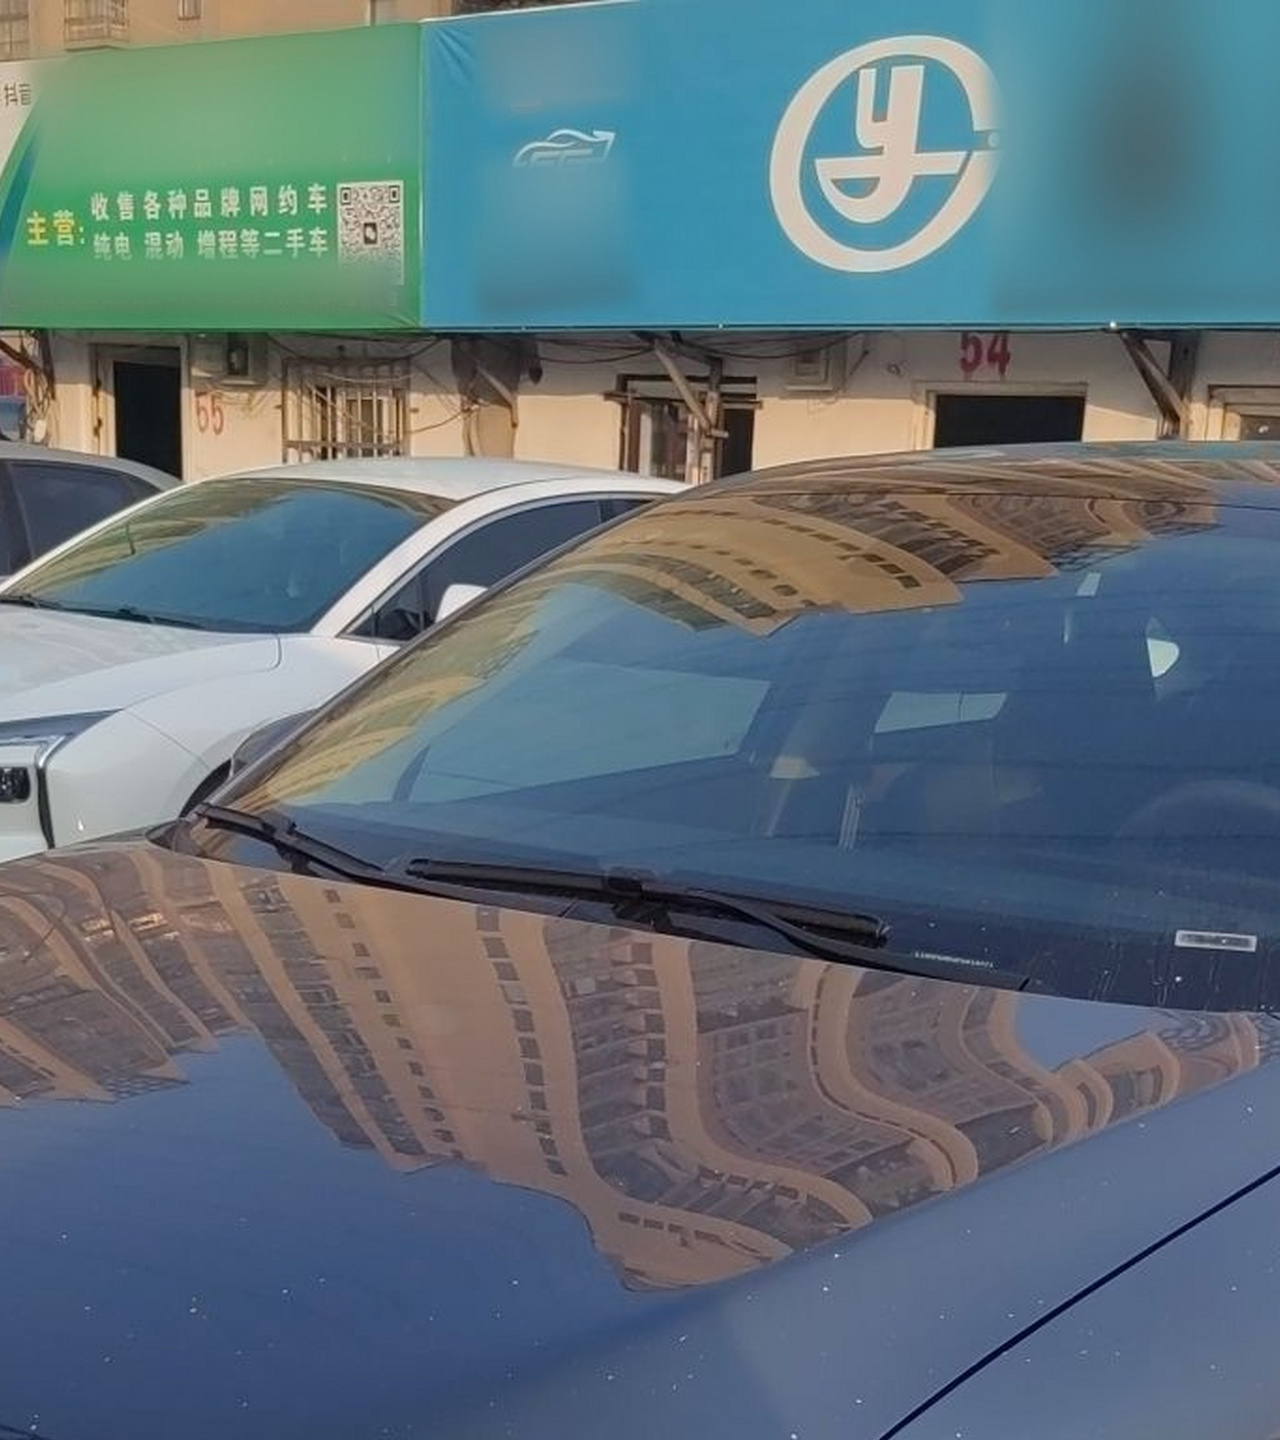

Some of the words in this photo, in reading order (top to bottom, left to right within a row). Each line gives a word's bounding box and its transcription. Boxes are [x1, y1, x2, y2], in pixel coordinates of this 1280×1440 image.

[91, 184, 327, 221] 收售各种品牌网约车
[960, 332, 1011, 377] 54
